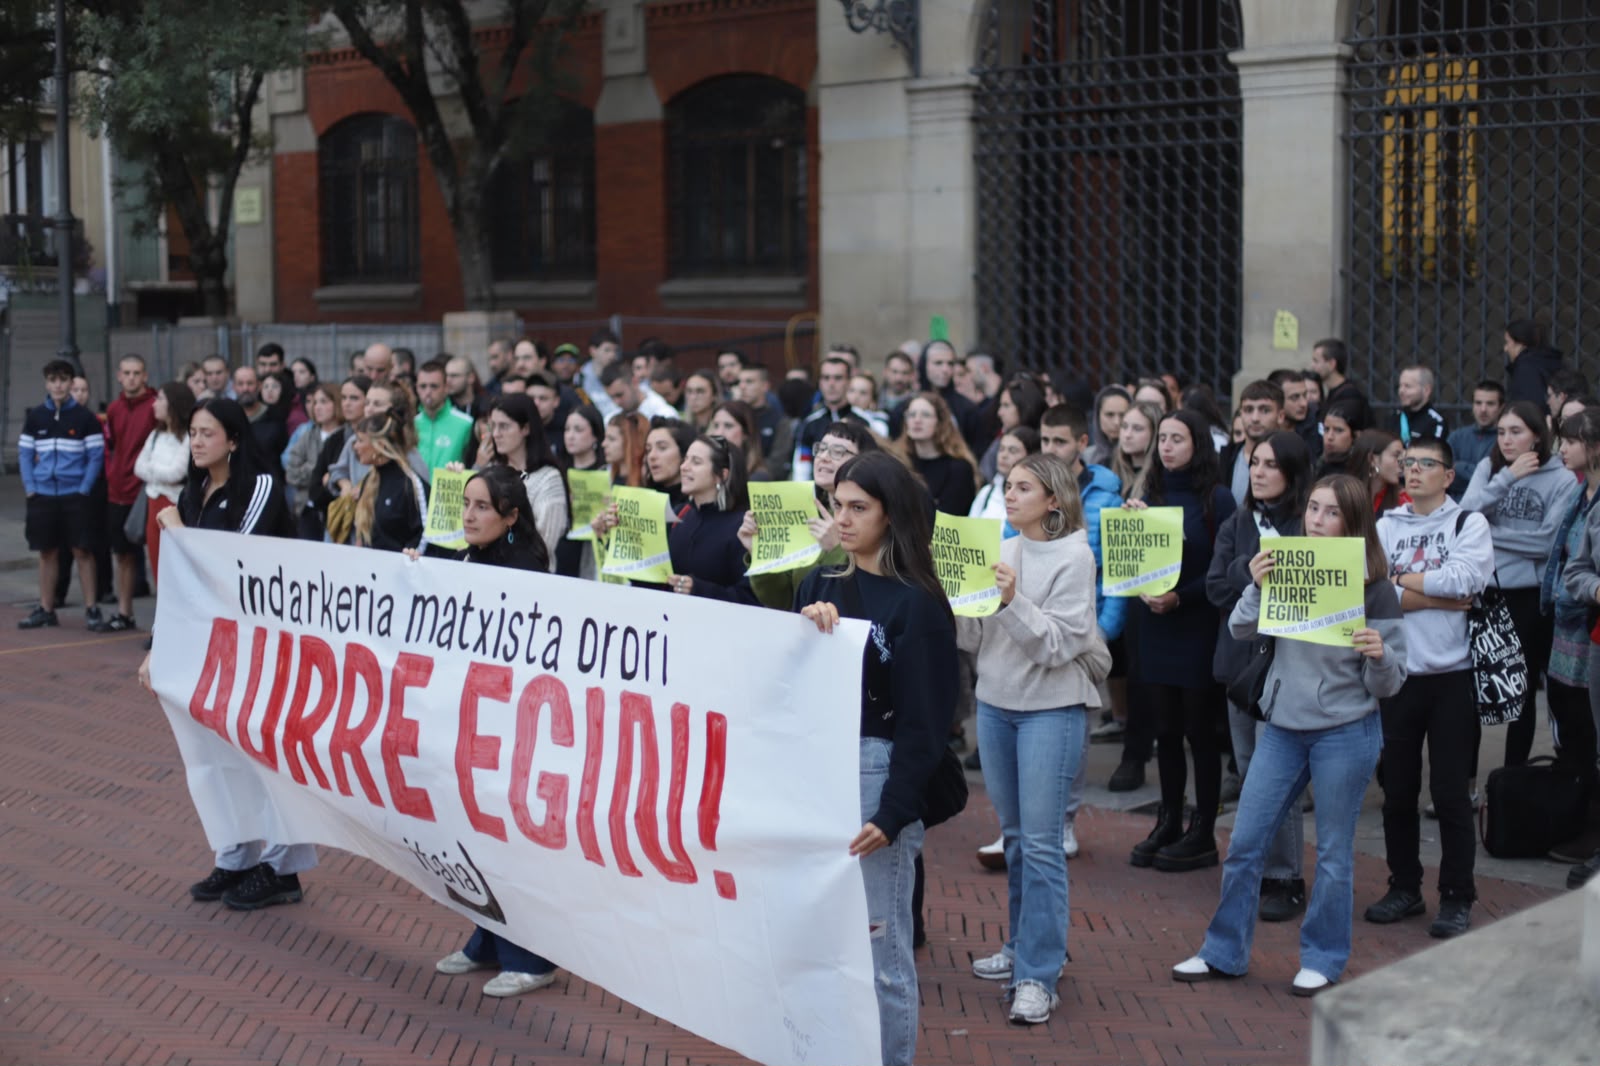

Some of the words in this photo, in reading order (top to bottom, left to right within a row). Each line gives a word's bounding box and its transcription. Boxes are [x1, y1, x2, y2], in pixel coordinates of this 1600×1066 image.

[437, 478, 462, 492] ERASO
[614, 497, 640, 516] RASO
[753, 494, 783, 510] ERASO
[432, 504, 461, 519] AURRE
[753, 510, 809, 526] MATXISTEI
[1106, 518, 1144, 532] ERASO
[615, 529, 644, 546] AURRE
[757, 527, 791, 543] AURRE
[933, 525, 961, 545] RASO
[1107, 533, 1170, 548] MATXISTEI
[1396, 532, 1445, 551] ALERTA
[613, 544, 643, 560] EGIN!
[757, 543, 785, 560] EGIN!
[1108, 548, 1146, 563] AURRE
[1108, 563, 1139, 577] EGIN!
[1267, 568, 1347, 587] MATXISTEI
[940, 579, 961, 598] IN!
[1268, 586, 1317, 604] AURRE
[1266, 604, 1309, 622] EGIN!
[237, 559, 394, 638] indarkeria
[405, 591, 563, 672] matxista
[577, 614, 669, 686] orori
[189, 617, 437, 822] AURRE
[455, 660, 737, 900] EGIN!
